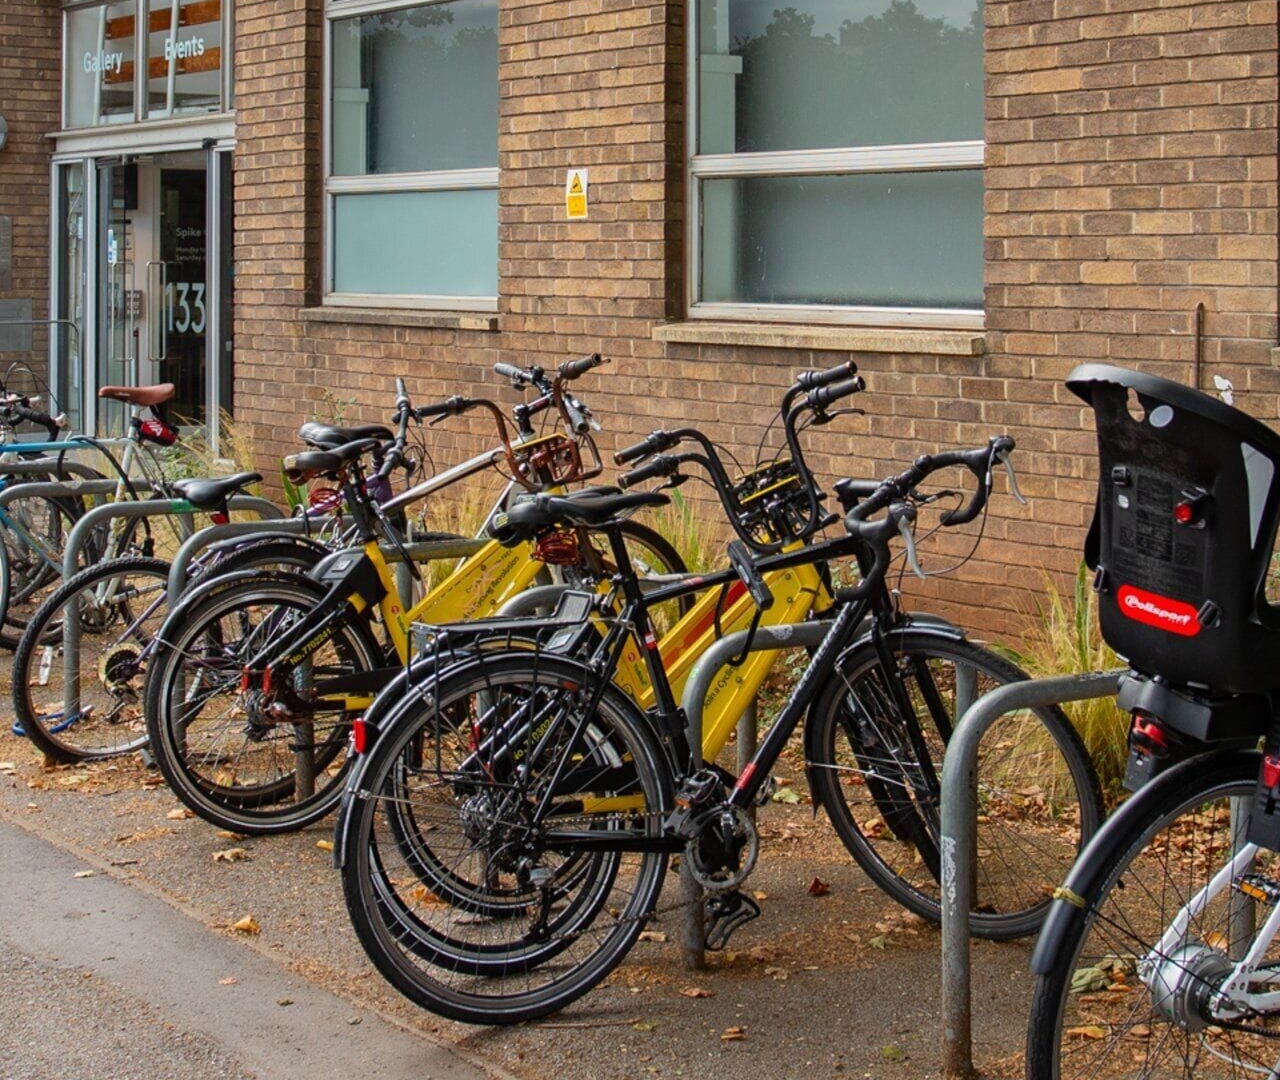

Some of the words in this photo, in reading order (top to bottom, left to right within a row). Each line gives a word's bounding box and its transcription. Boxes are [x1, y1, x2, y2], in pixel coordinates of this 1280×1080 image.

[83, 50, 123, 74] Gallery
[164, 35, 205, 61] Events
[176, 227, 201, 239] Spike
[165, 282, 206, 334] 133
[1124, 594, 1191, 624] Polisport
